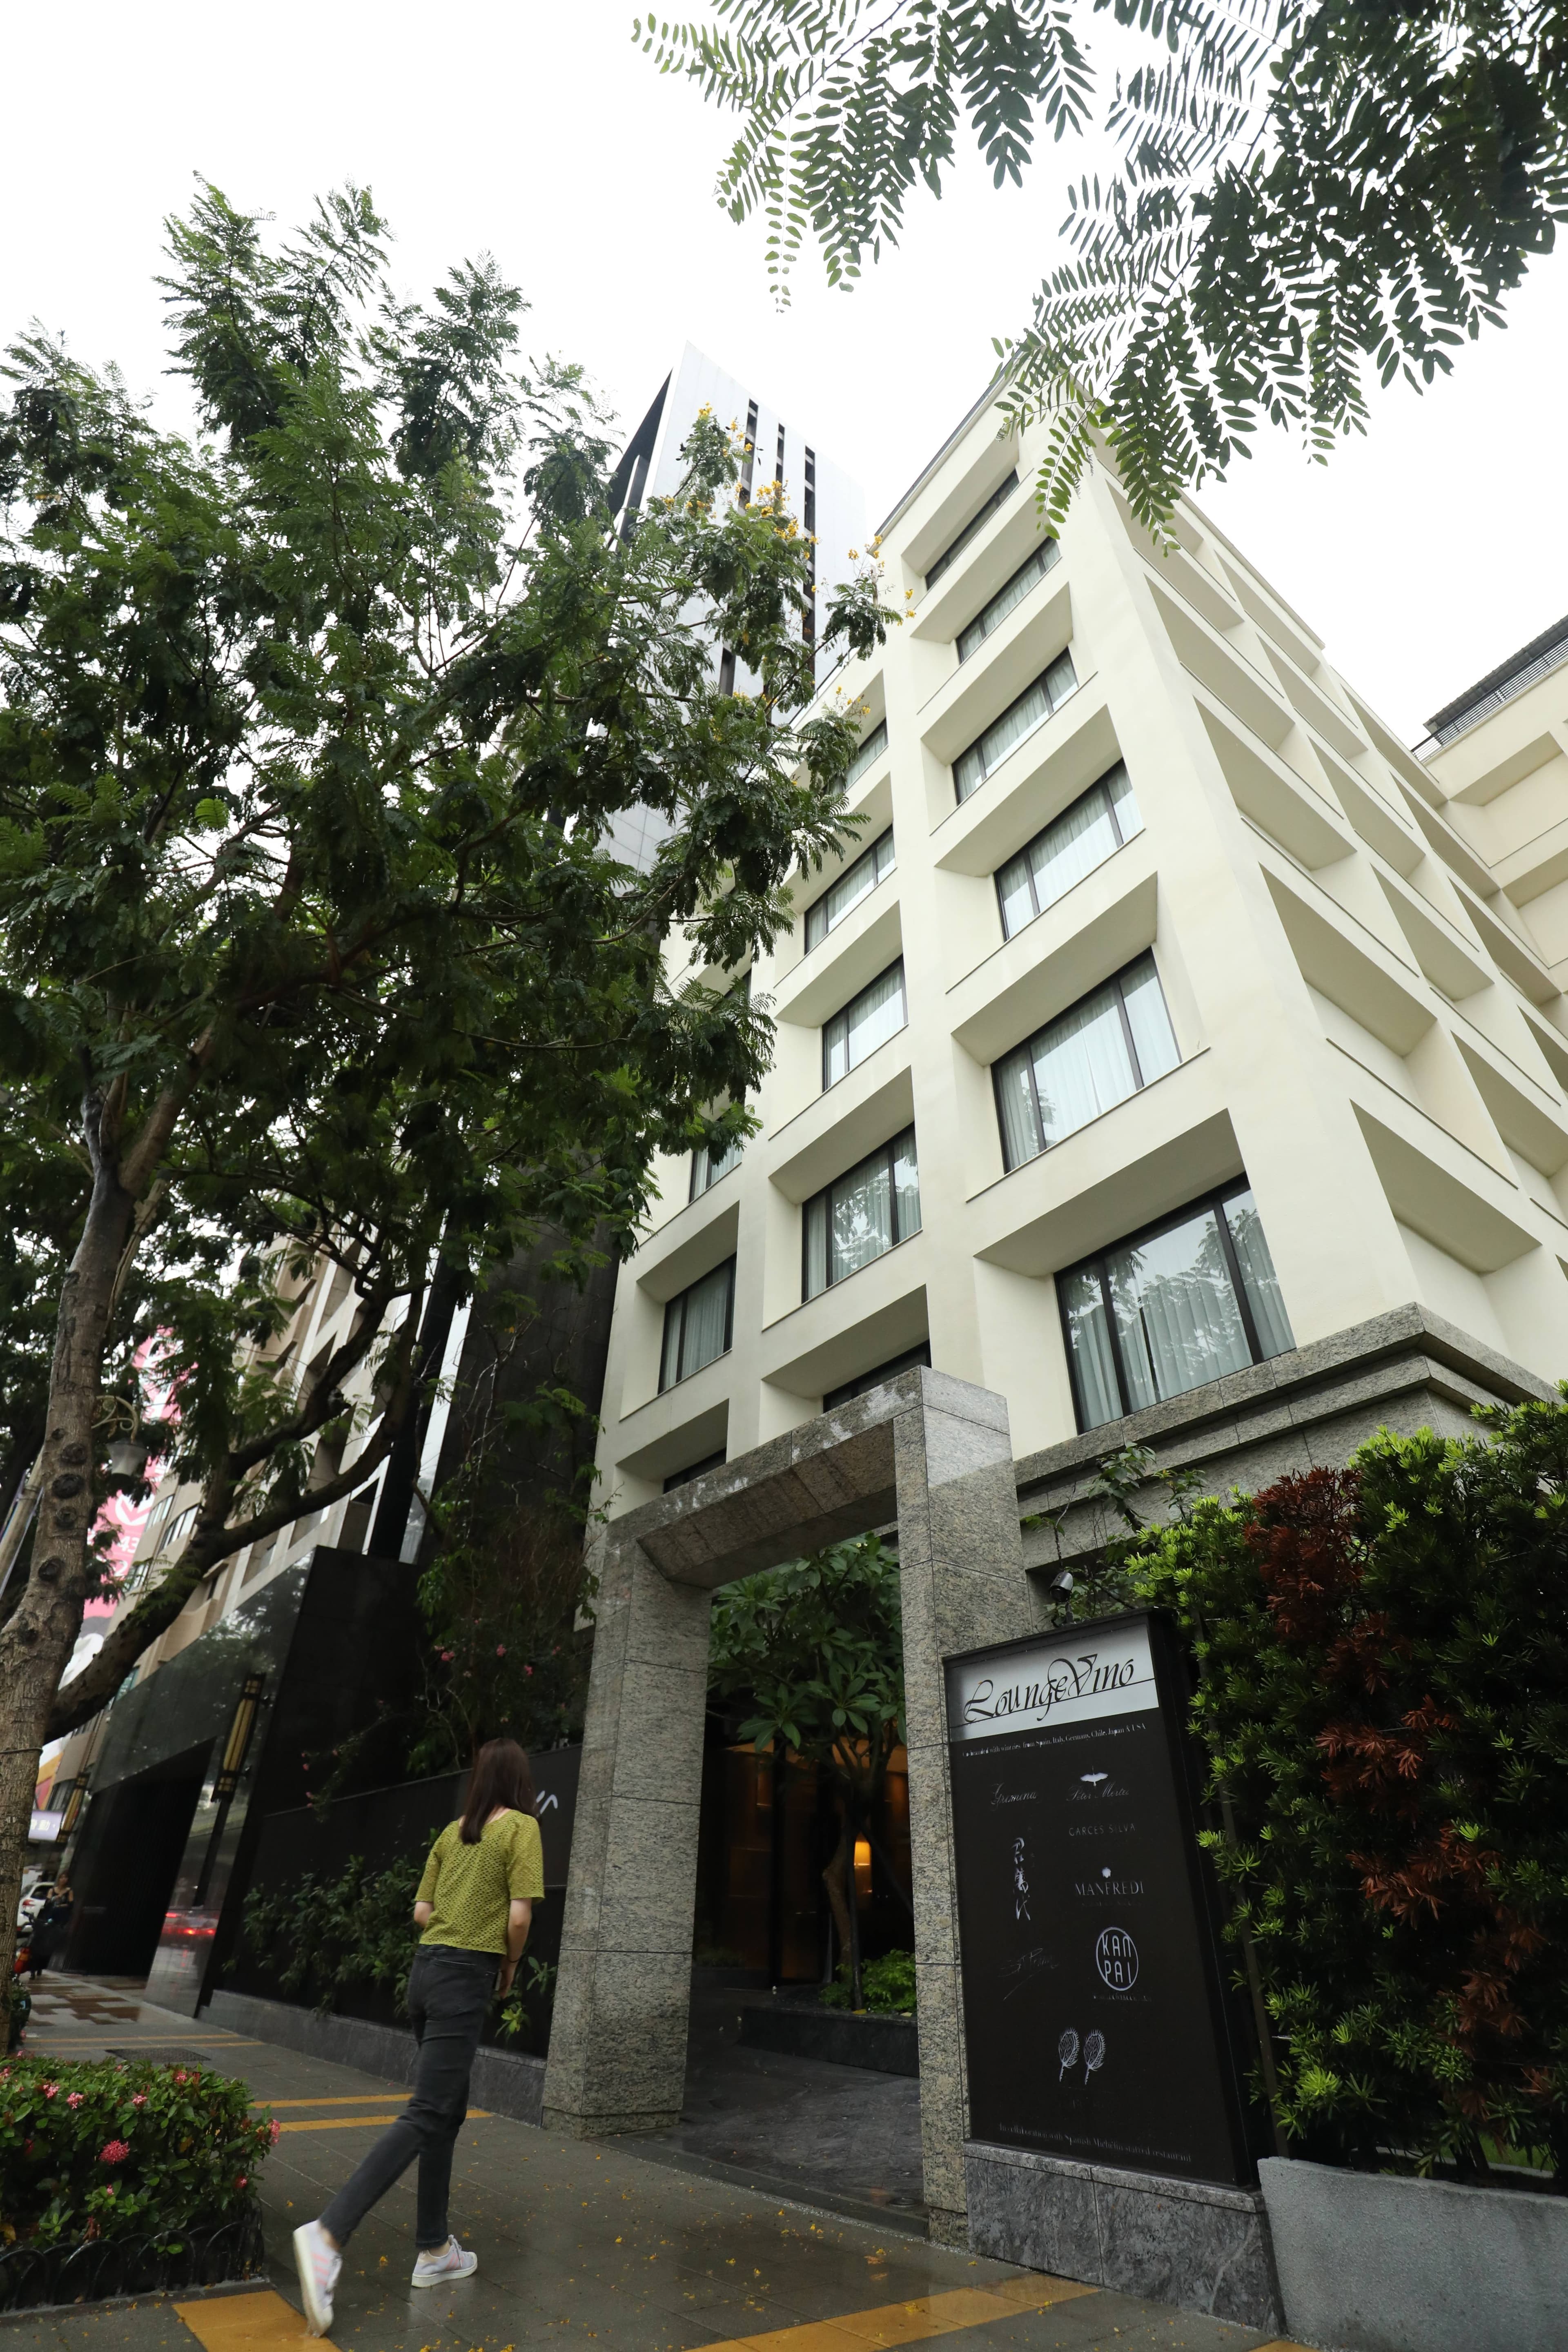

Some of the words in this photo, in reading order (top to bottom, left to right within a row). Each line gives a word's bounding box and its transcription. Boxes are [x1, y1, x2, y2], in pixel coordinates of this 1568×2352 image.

[1001, 1743, 1021, 1751] wineries
[1036, 1738, 1052, 1748] Spain,
[1052, 1735, 1065, 1744] Italy,
[1065, 1733, 1090, 1741] Germany,
[1107, 1728, 1124, 1736] Japan
[1075, 1881, 1144, 1896] MANFREDI
[1104, 1960, 1132, 1984] PAI
